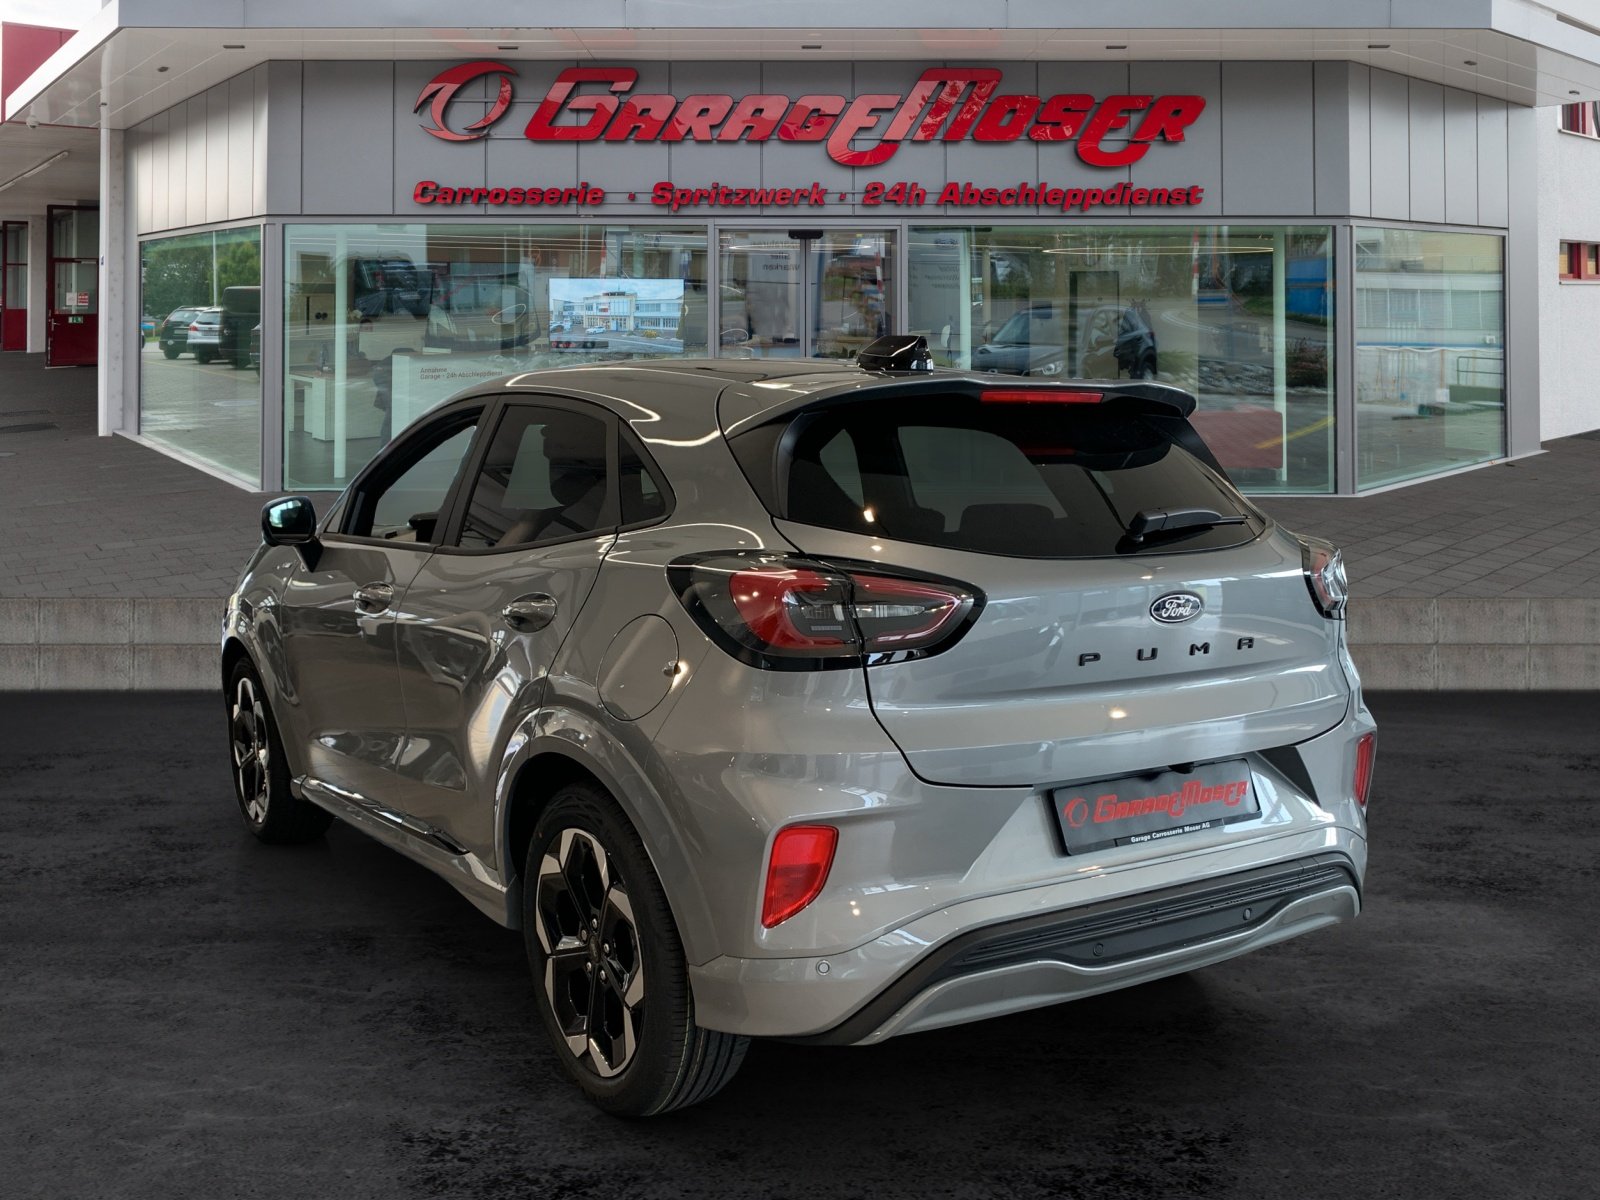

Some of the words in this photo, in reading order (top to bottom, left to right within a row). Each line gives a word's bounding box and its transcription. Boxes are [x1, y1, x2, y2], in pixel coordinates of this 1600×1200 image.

[413, 181, 605, 206] Carrosserie
[651, 181, 827, 212] Spritzwerk
[862, 181, 927, 207] 24h
[937, 182, 1204, 213] Abschleppdienst
[1161, 599, 1192, 618] Ford
[1078, 637, 1255, 666] PUMA
[1131, 835, 1151, 843] Garage
[1152, 828, 1182, 839] Carrosserie
[1184, 825, 1201, 833] Moser
